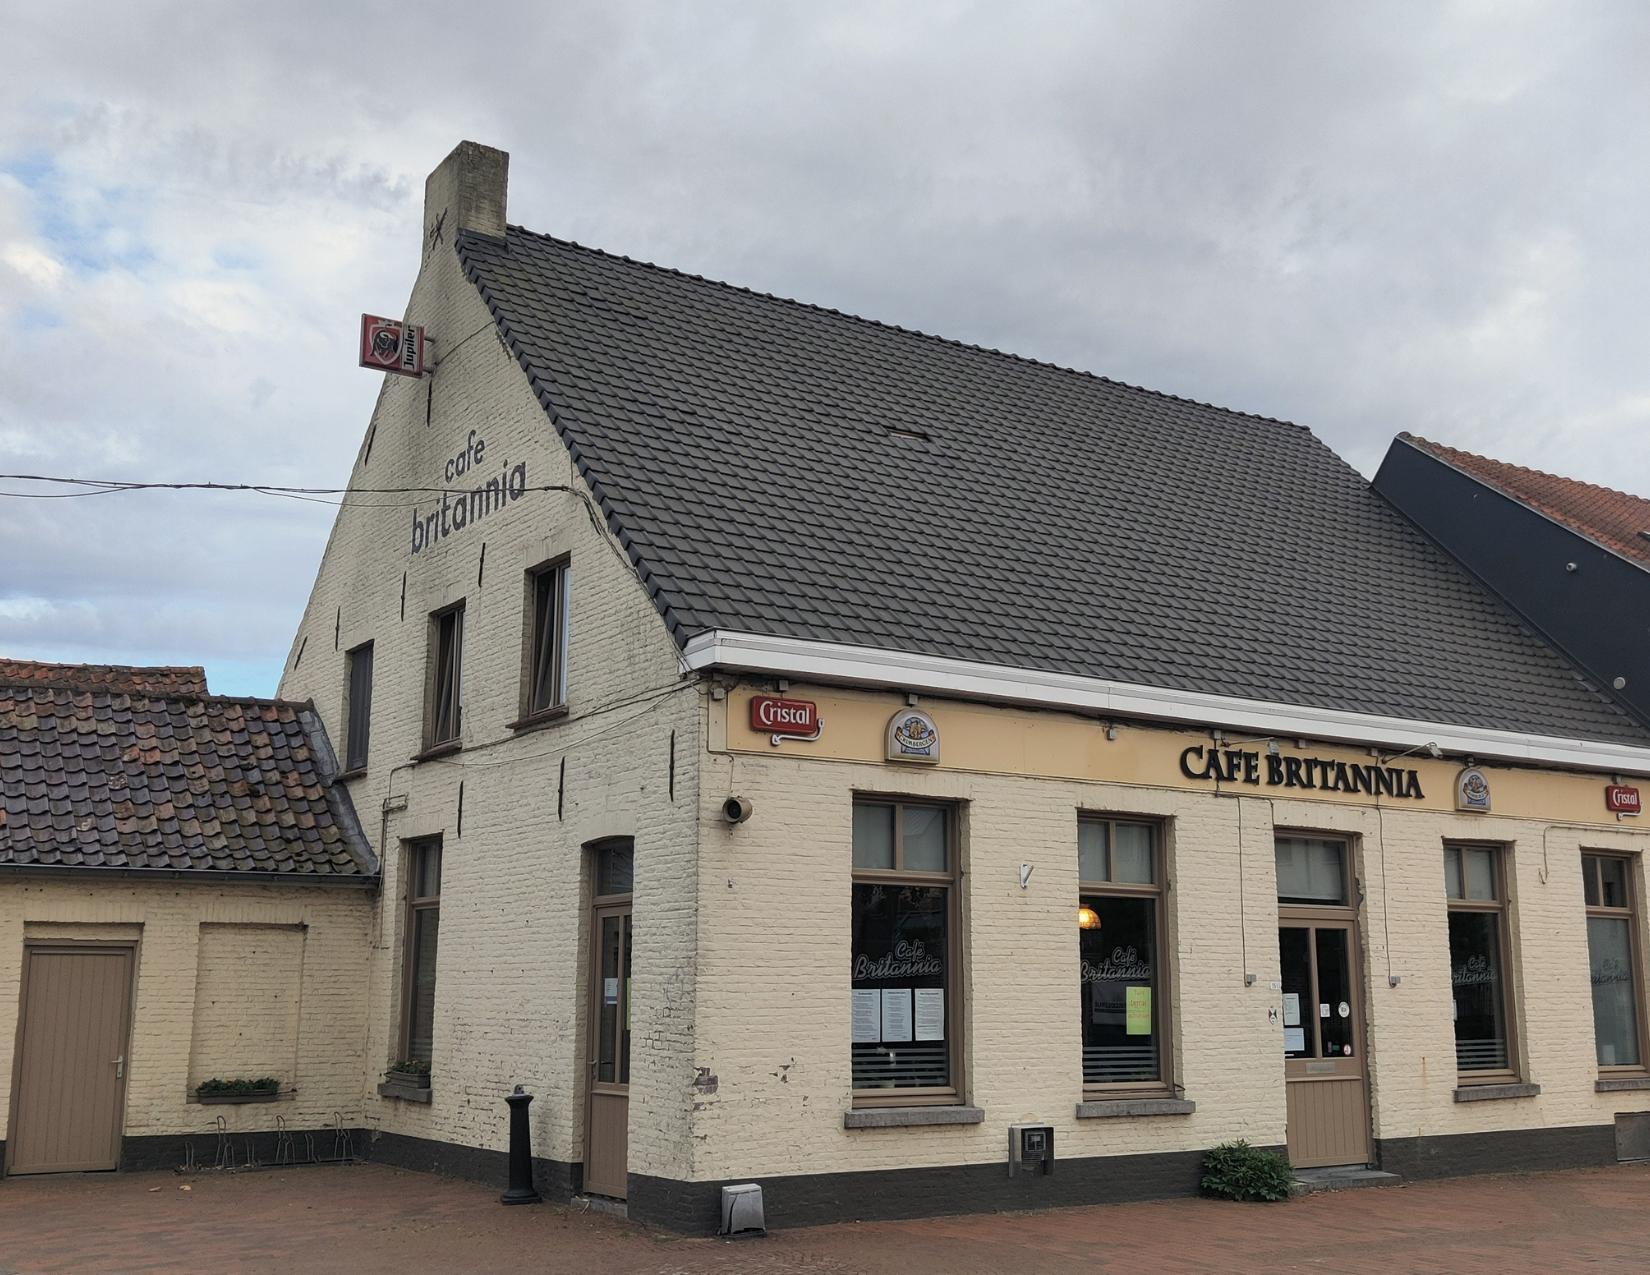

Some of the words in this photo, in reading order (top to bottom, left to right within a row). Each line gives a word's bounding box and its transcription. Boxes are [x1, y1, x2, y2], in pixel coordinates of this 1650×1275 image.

[403, 325, 417, 370] Jupiler
[444, 429, 486, 483] cafe
[411, 459, 527, 554] britannia
[759, 700, 811, 726] Cristal
[1180, 745, 1260, 786] CAFE
[1266, 754, 1425, 799] BRITANNIA
[1612, 789, 1638, 806] Cristal
[896, 939, 926, 961] Café
[1113, 946, 1137, 966] Café
[853, 952, 943, 980] Britannia
